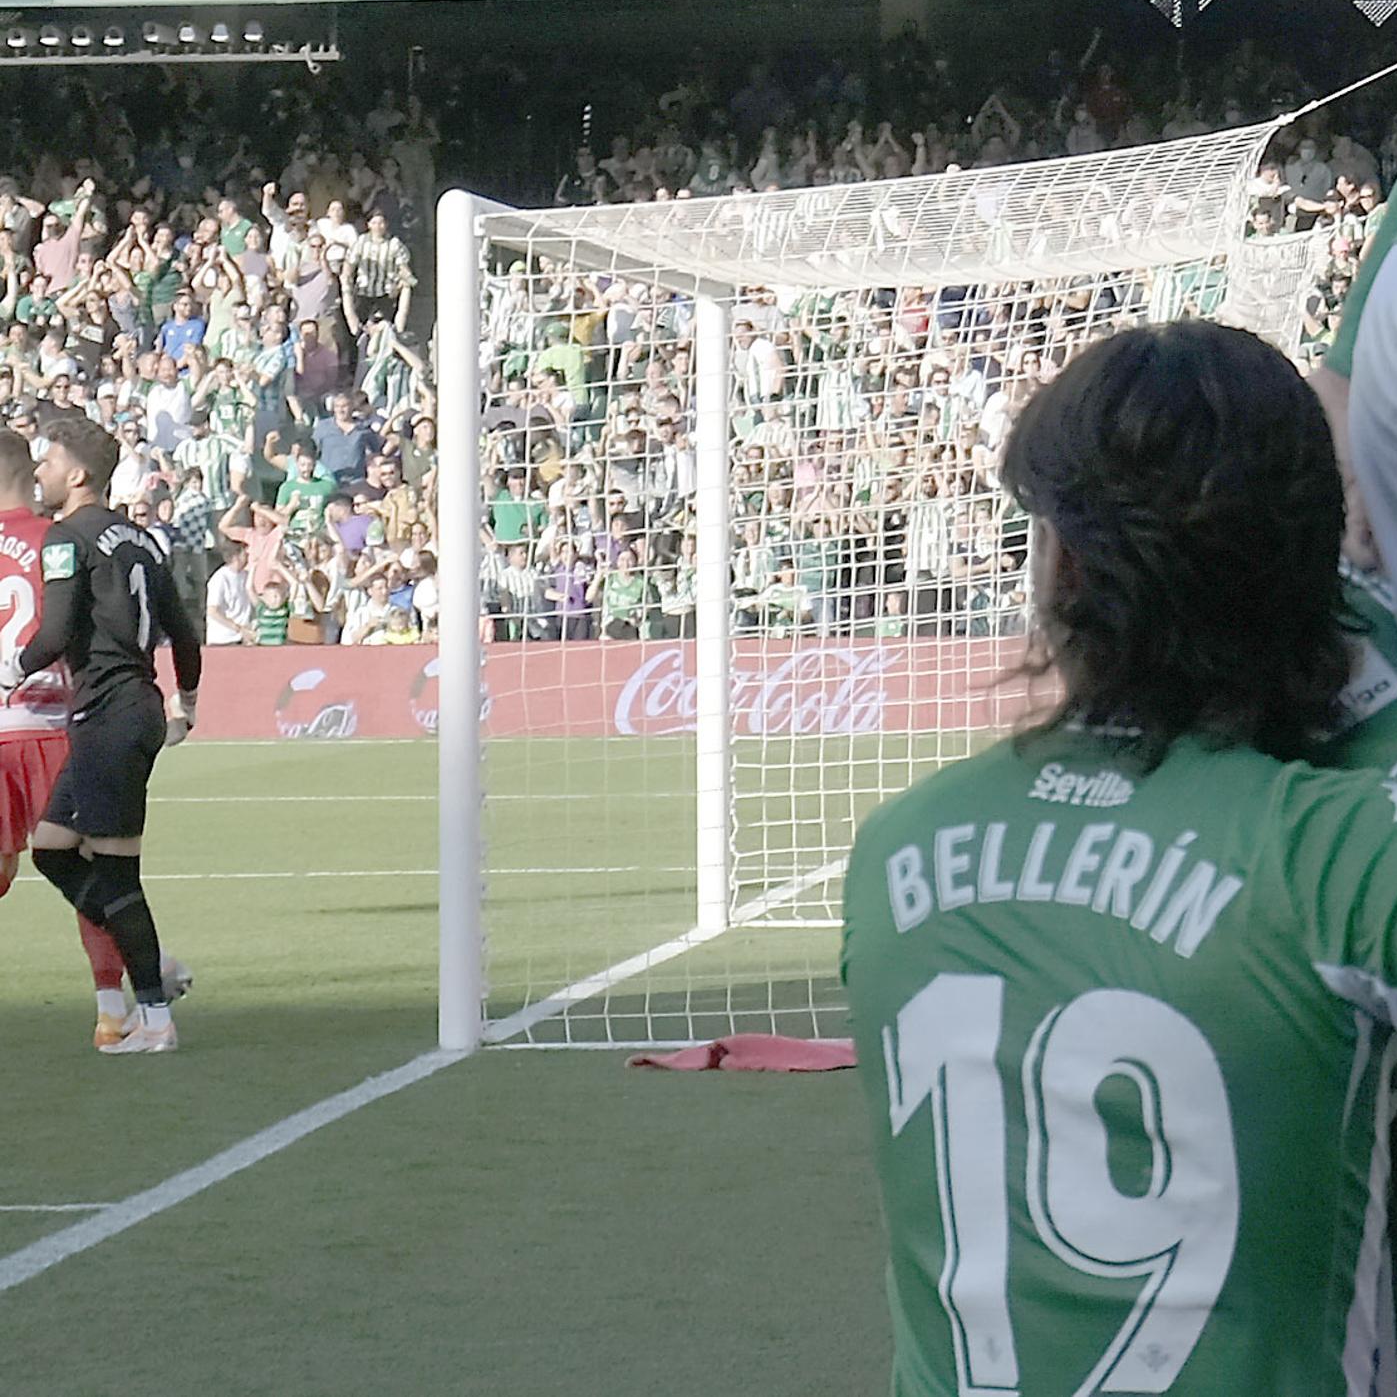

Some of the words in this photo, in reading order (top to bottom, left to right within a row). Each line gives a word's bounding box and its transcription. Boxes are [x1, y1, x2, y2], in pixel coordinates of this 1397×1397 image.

[129, 563, 150, 651] 1
[1028, 762, 1134, 806] Sevilla
[886, 822, 1244, 959] BELLERÍN
[883, 973, 1241, 1397] 19
